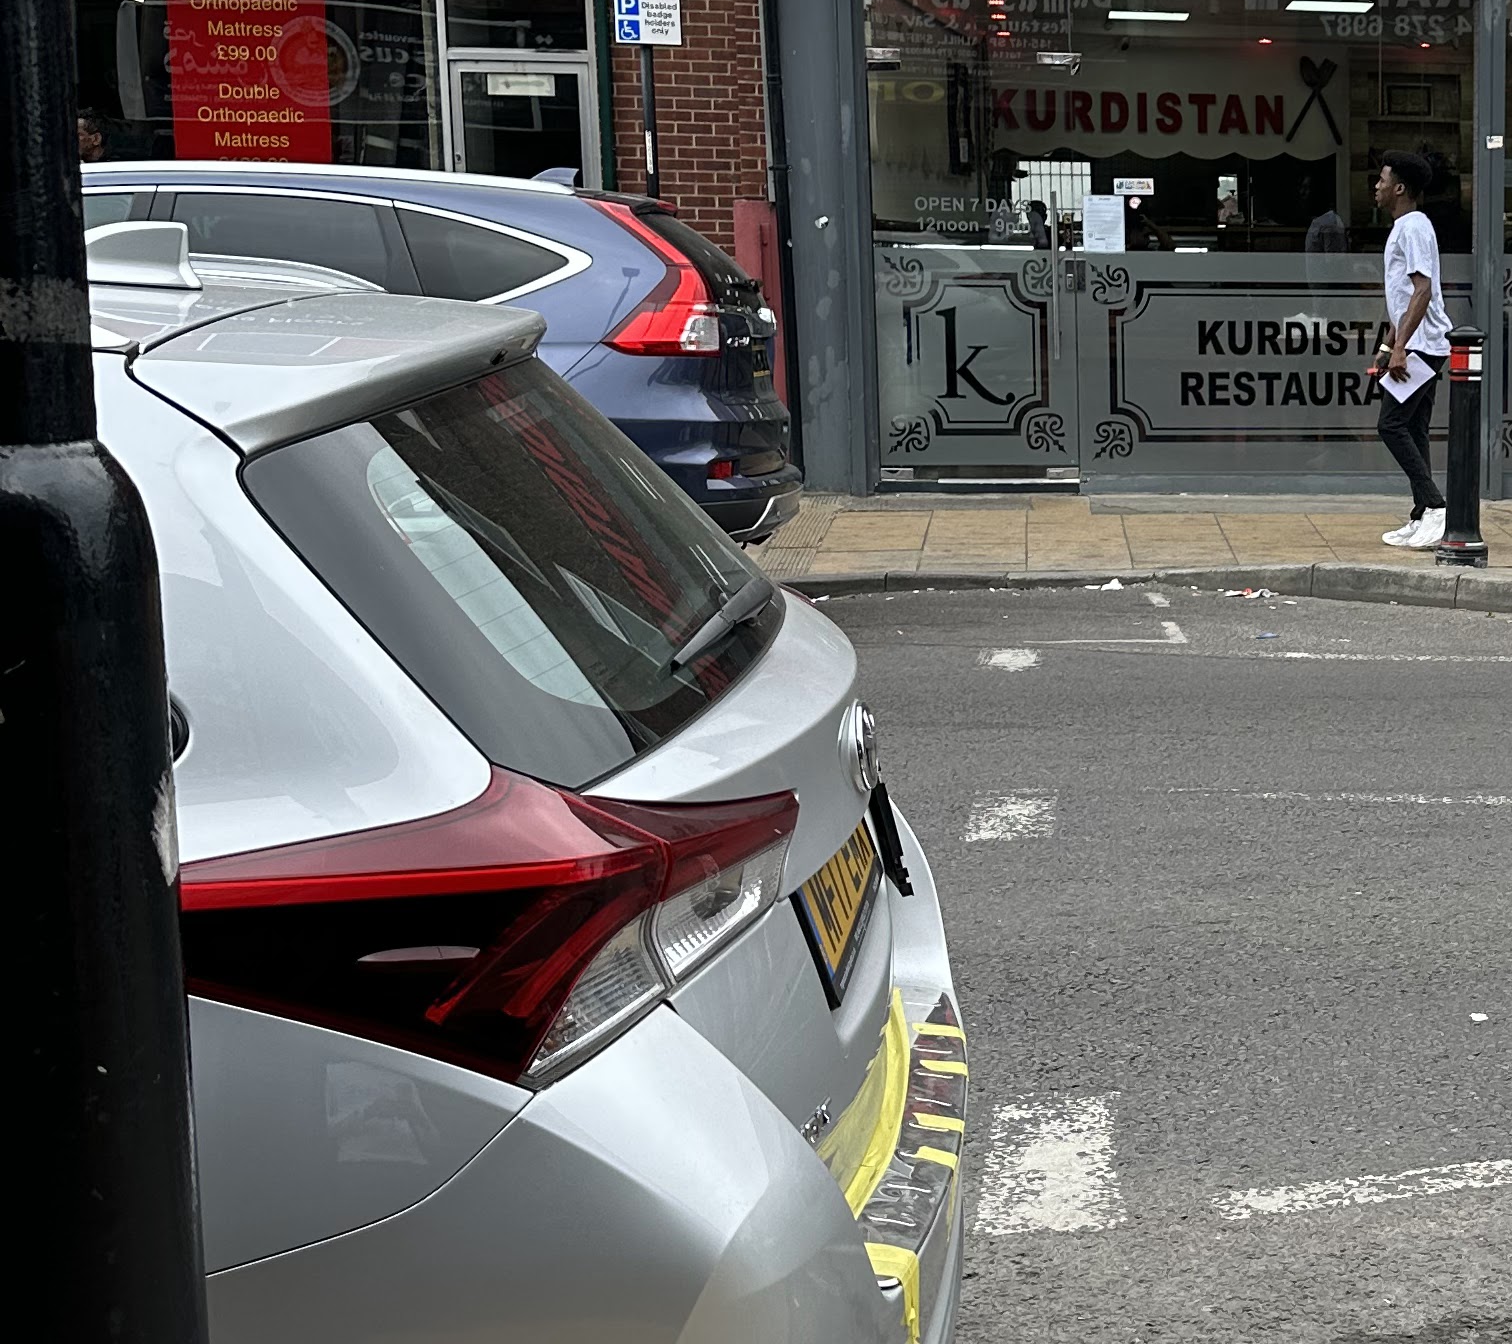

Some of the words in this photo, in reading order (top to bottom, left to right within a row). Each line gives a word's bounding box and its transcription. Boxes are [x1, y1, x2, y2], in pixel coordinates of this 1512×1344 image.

[641, 1, 678, 10] Disabled
[644, 19, 676, 27] holders
[646, 11, 673, 19] badge
[207, 21, 283, 37] Mattress
[651, 27, 670, 35] only
[217, 46, 278, 61] £99.00
[218, 83, 280, 99] Double
[197, 106, 304, 126] Orthopaedic
[991, 88, 1285, 136] KURDISTAN
[214, 131, 290, 147] Mattress
[914, 197, 965, 212] OPEN
[970, 198, 979, 212] 7
[985, 198, 1032, 214] DAYS
[916, 216, 980, 232] 12noon
[995, 218, 1032, 236] 9pm
